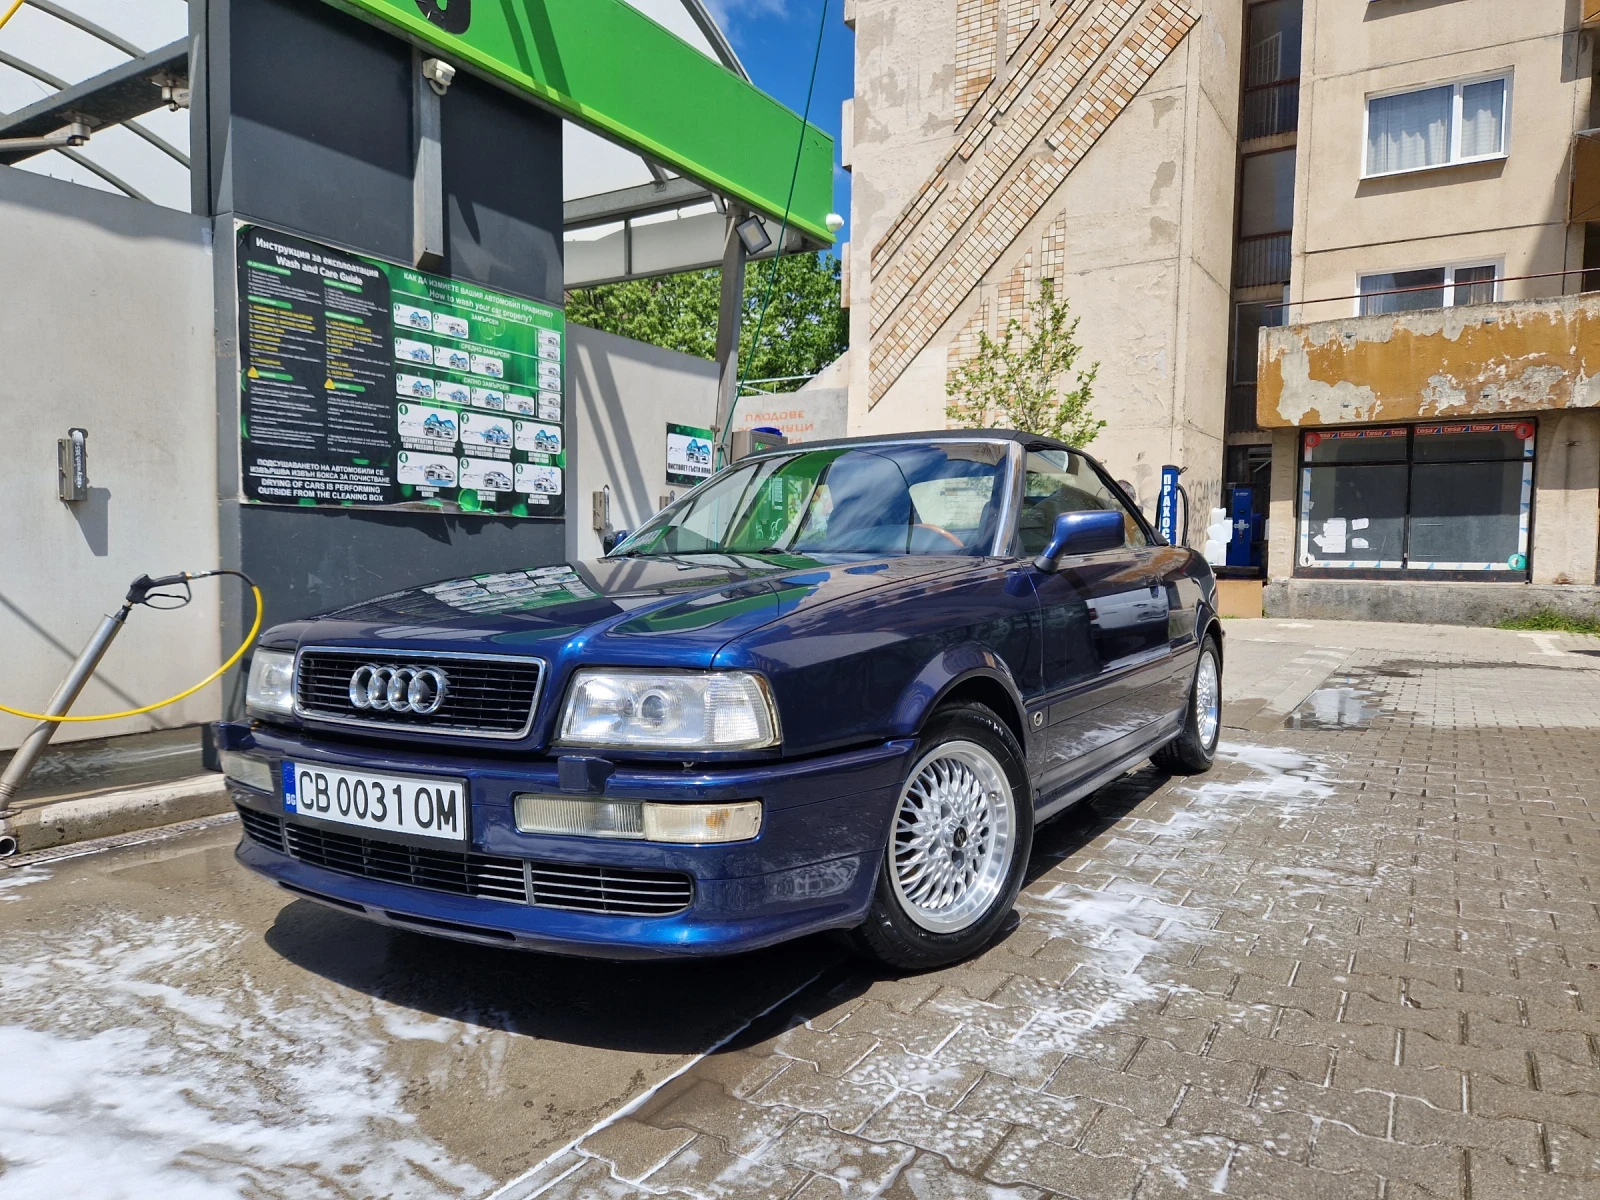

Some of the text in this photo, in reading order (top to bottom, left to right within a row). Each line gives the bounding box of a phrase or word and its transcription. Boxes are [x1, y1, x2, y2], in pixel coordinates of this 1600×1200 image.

[255, 237, 380, 278] Инструкция за експлоатация
[276, 255, 301, 270] Wash
[301, 262, 319, 275] and
[320, 268, 339, 280] Care
[339, 272, 363, 286] Guide
[403, 271, 418, 283] КАК
[417, 275, 428, 286] ДА
[429, 279, 460, 294] ИЗМИЕТЕ
[460, 286, 484, 300] ВАШИЯ
[484, 292, 521, 310] АВТОМОБИЛ
[429, 289, 533, 324] How to wash your car properly?
[471, 313, 500, 326] ЗАМЪРСЕН
[745, 410, 805, 422] ПЛОДОВЕ
[250, 466, 291, 476] ИЗВЪРШВА
[292, 469, 315, 478] ИЗВЪН
[316, 472, 338, 480] БОКСА
[349, 474, 390, 483] ПОЧИСТВАНЕ
[257, 458, 319, 471] ПОДСУШАВАНЕТО
[320, 463, 330, 471] НА
[331, 464, 375, 475] АВТОМОБИЛИ
[258, 486, 384, 501] OUTSIDE FROM THE CLEANING BOX
[261, 478, 291, 488] DRYING
[304, 481, 325, 490] CARS
[335, 484, 380, 494] PERFORMING
[1161, 474, 1171, 544] ПРАХОС
[286, 793, 297, 806] BG
